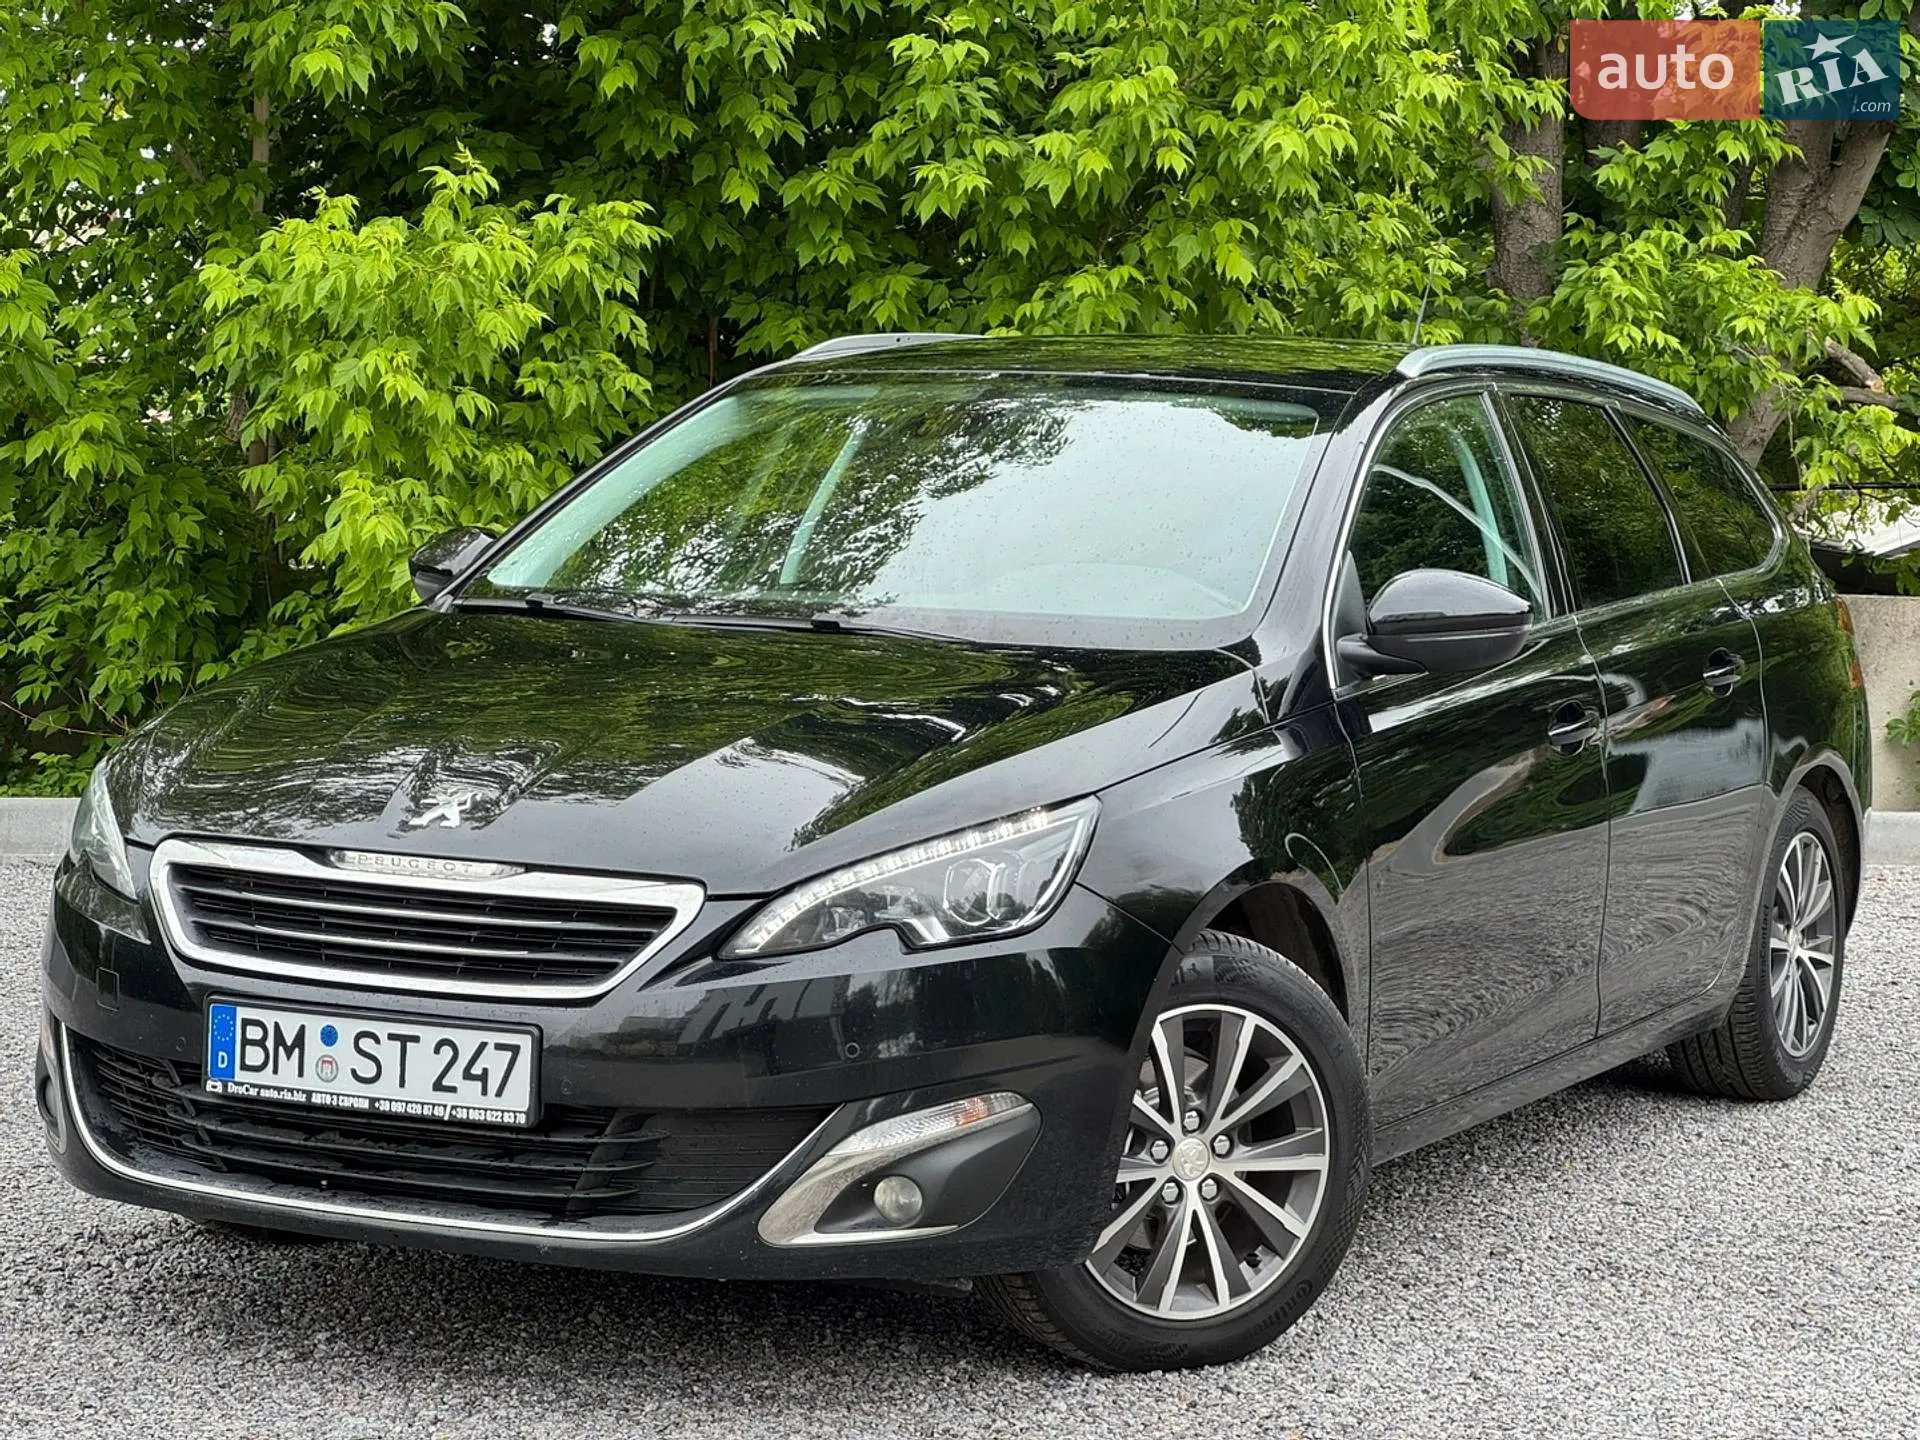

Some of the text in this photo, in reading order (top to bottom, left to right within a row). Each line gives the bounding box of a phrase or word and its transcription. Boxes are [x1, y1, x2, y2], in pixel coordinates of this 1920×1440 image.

[357, 854, 473, 873] PEUGEOT
[218, 1051, 228, 1068] D
[239, 1017, 521, 1098] BM ST 247
[227, 1082, 307, 1102] DroCar auto.ria.biz
